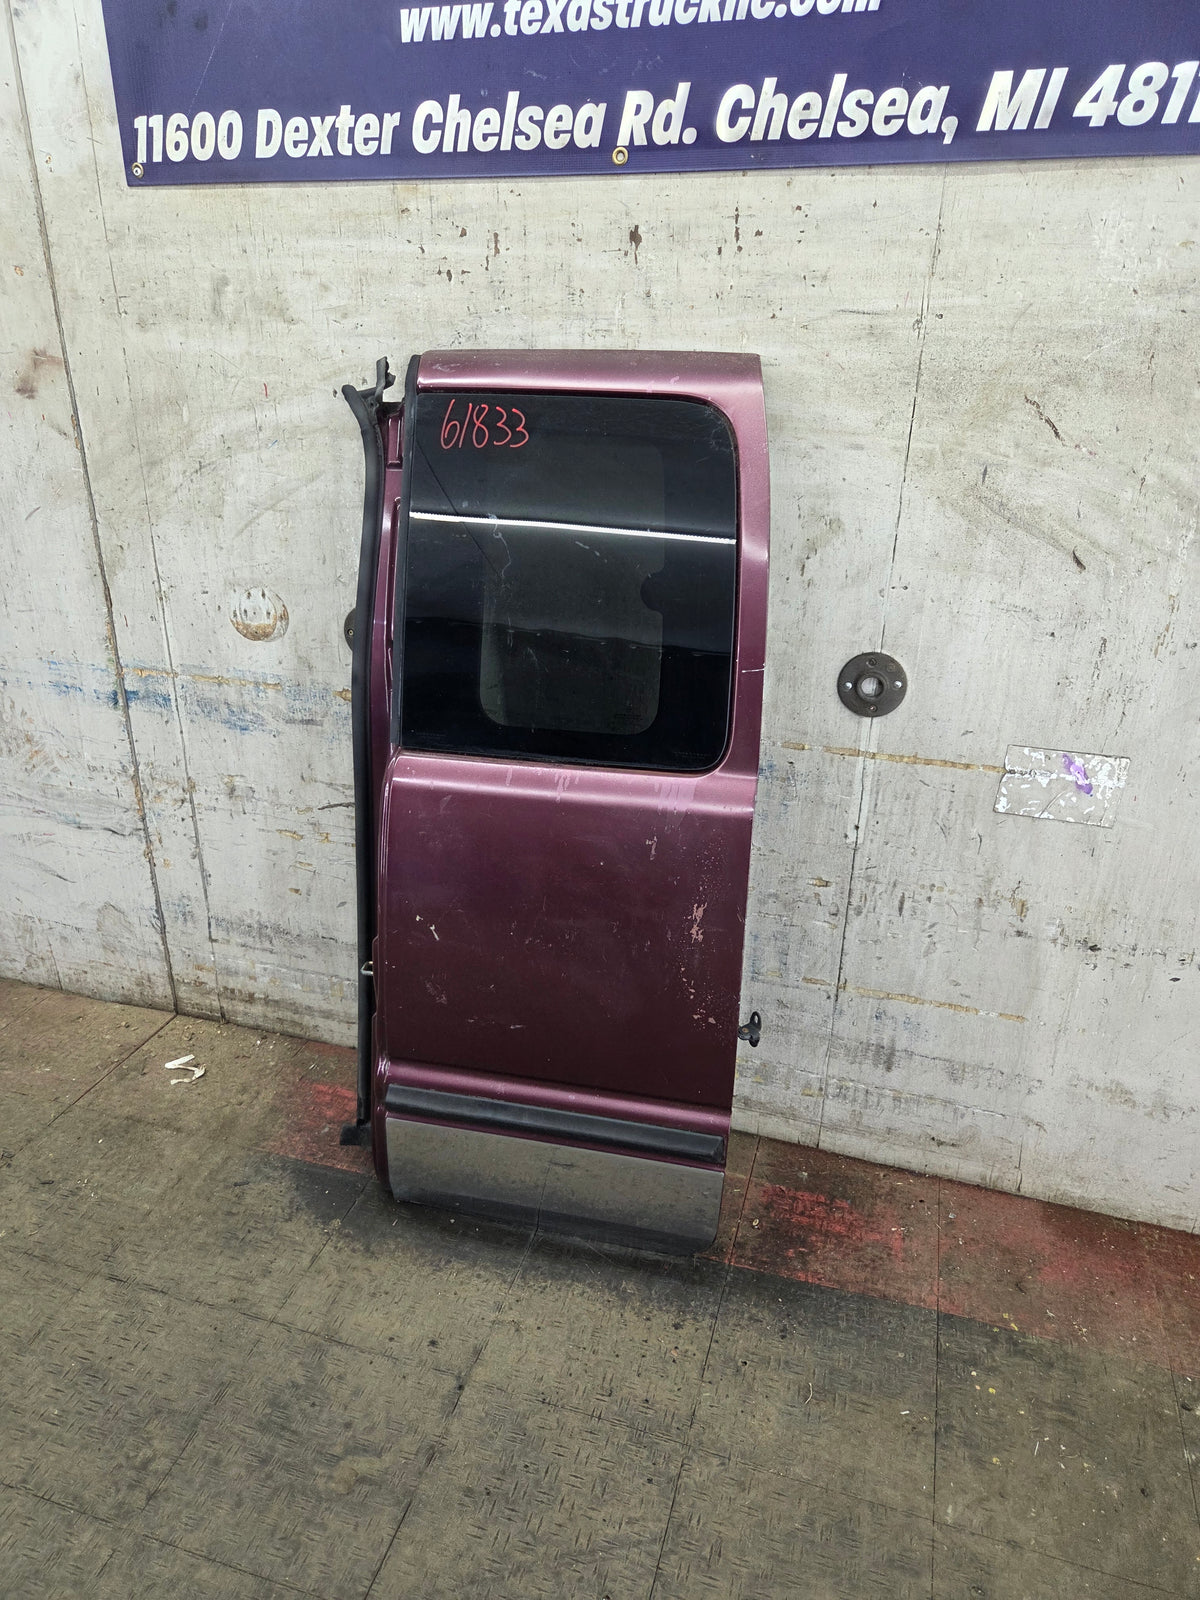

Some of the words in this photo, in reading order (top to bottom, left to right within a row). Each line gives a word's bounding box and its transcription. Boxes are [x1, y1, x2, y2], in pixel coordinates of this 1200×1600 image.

[133, 109, 243, 163] 11600
[255, 104, 401, 158] Dexter
[411, 91, 607, 155] Chelsea
[616, 82, 698, 146] Rd.
[715, 73, 958, 144] Chelsea,
[975, 67, 1070, 131] MI
[1072, 60, 1200, 128] 481
[440, 398, 530, 450] 61833
